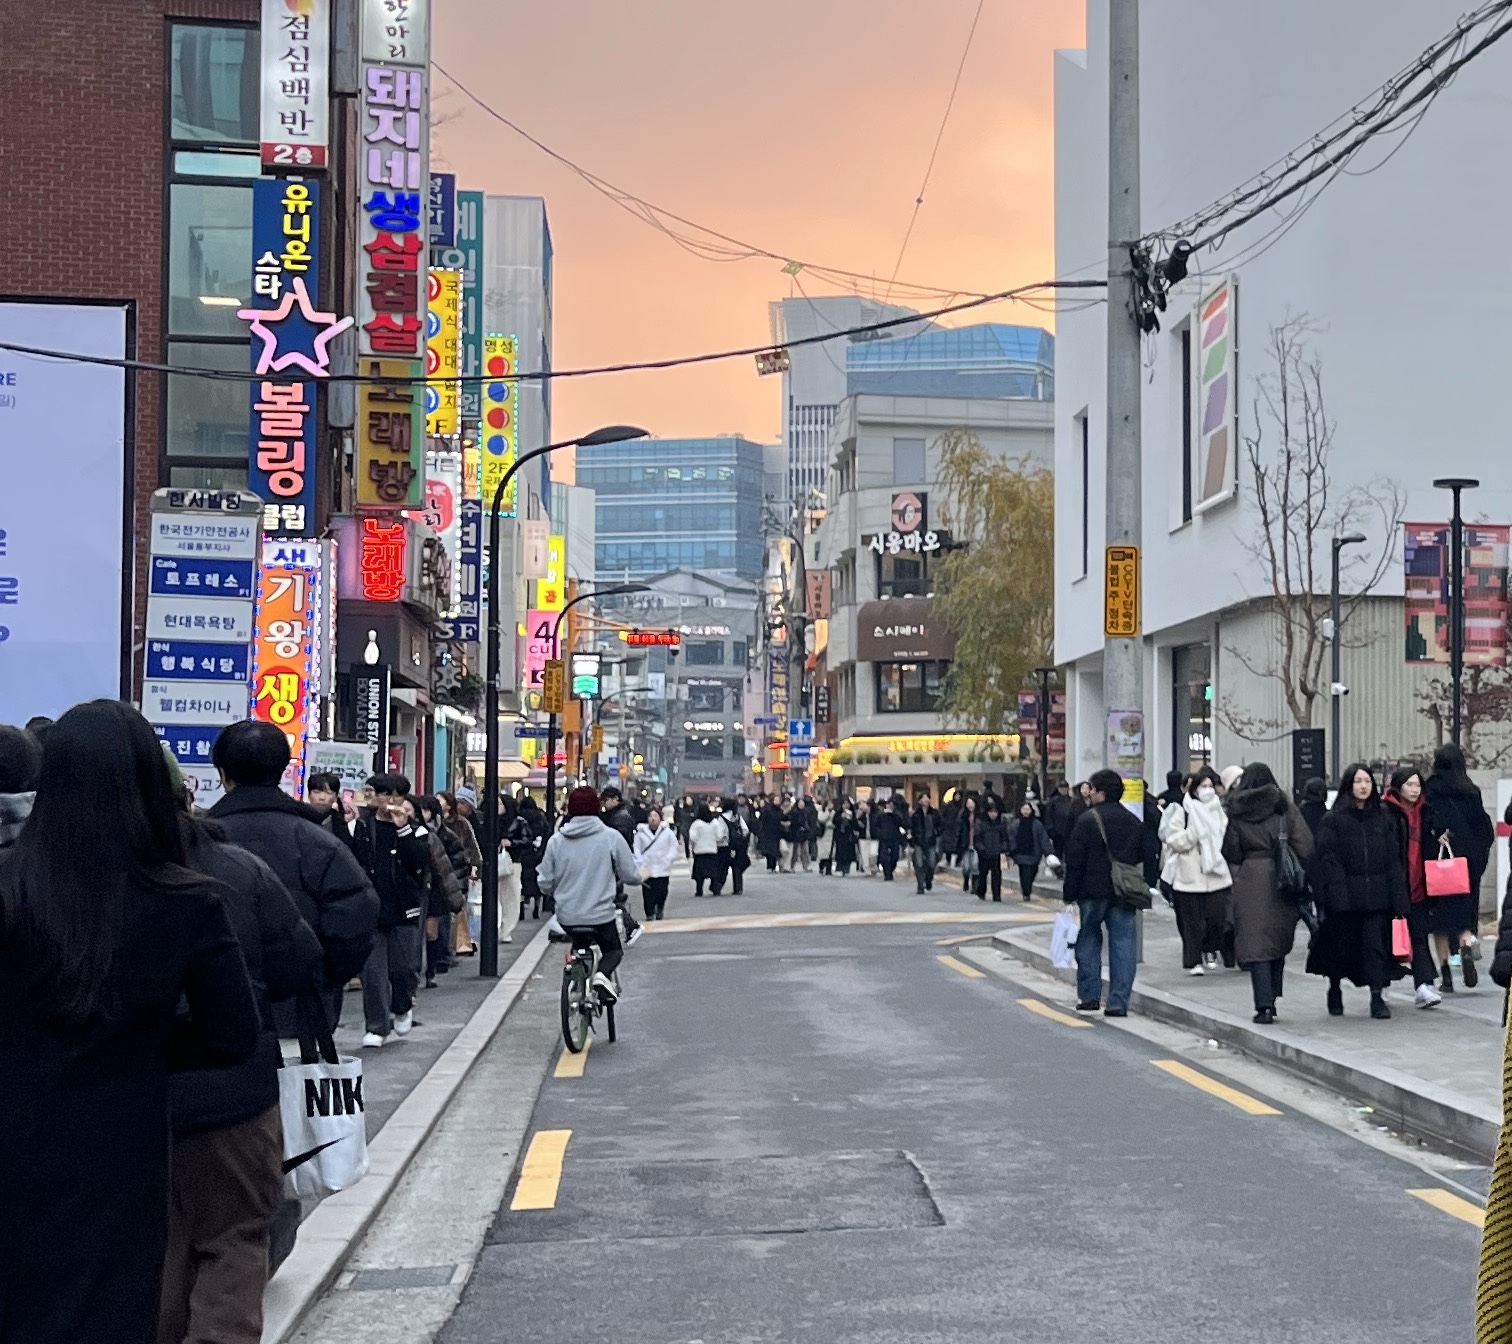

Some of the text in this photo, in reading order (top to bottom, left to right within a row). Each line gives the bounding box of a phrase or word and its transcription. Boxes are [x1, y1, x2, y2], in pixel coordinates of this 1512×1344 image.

[278, 14, 315, 137] 점심백반
[280, 183, 313, 271] 유니온
[255, 251, 282, 300] 스타
[253, 381, 310, 497] 볼링
[488, 462, 510, 474] 2F
[159, 523, 251, 539] 한국전기안전공사
[867, 529, 941, 556] 시옹마오
[361, 517, 407, 602] 노래방
[164, 613, 236, 631] 현대목욕탕
[368, 678, 381, 719] UNION
[304, 1074, 365, 1118] NIK
